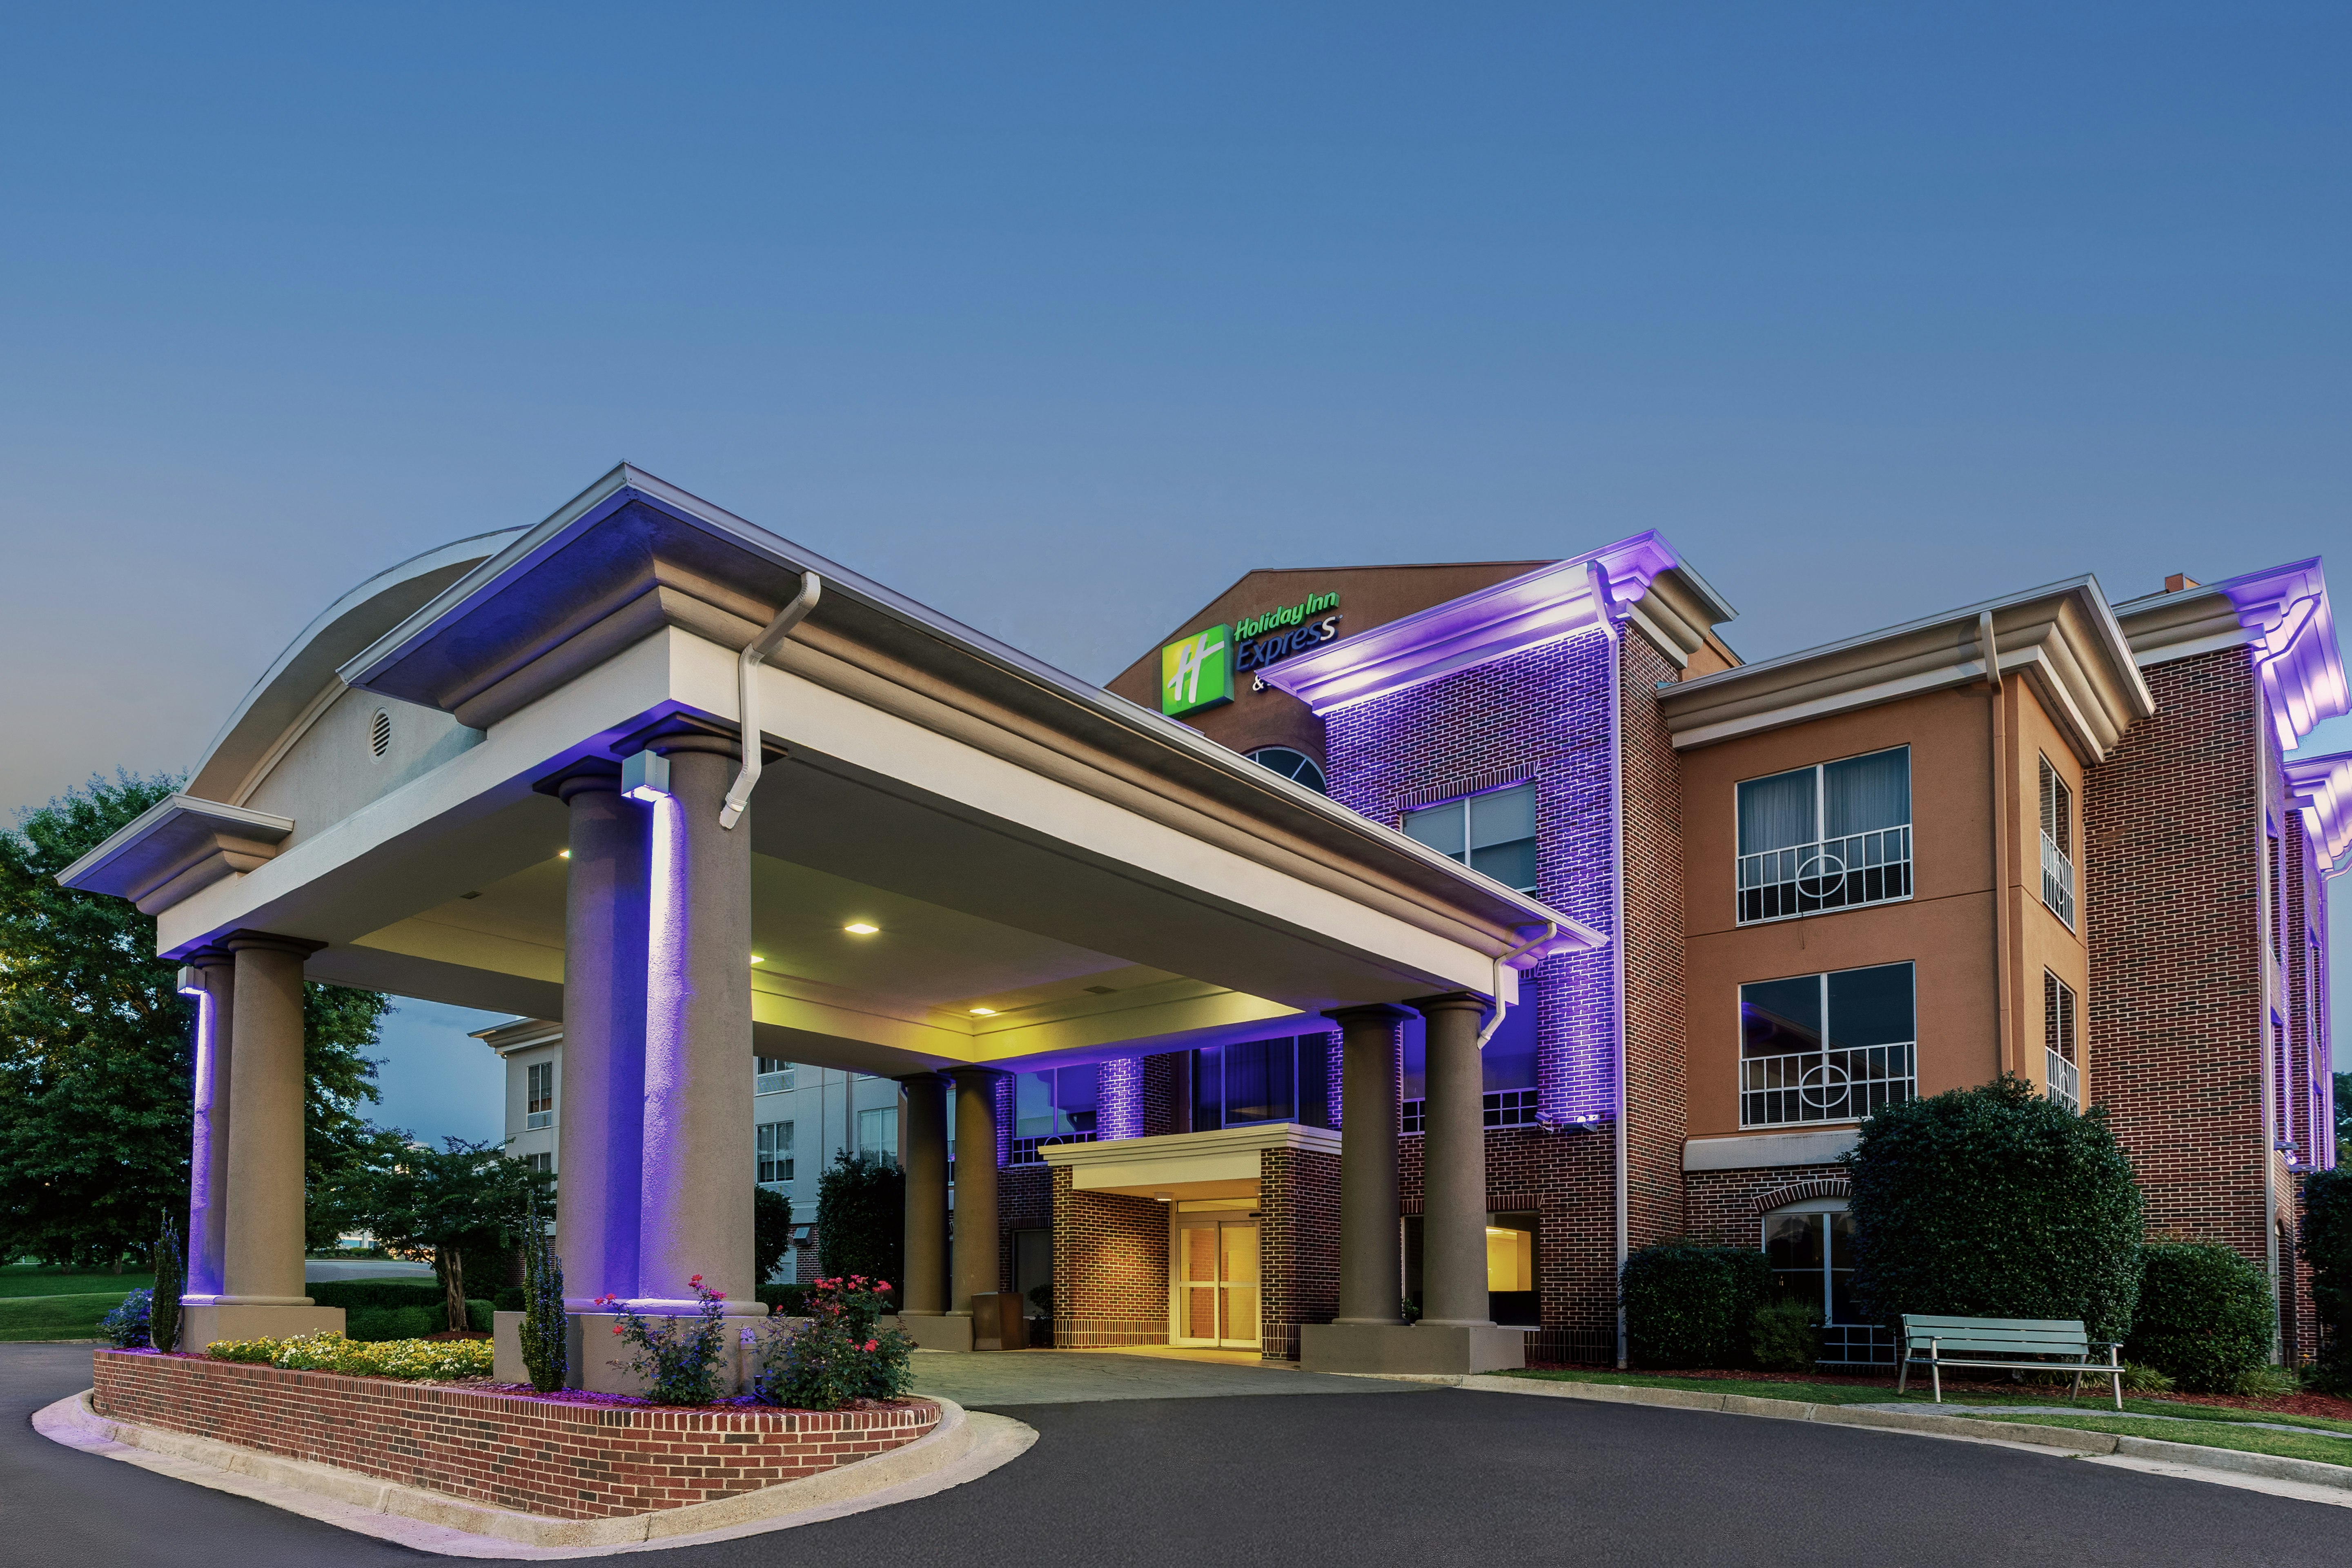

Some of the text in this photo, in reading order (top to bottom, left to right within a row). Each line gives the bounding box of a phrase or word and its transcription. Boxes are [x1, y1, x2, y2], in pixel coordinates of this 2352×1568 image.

[1234, 591, 1337, 641] Holiday Inn
[1236, 616, 1337, 671] Express
[1252, 675, 1264, 691] &
